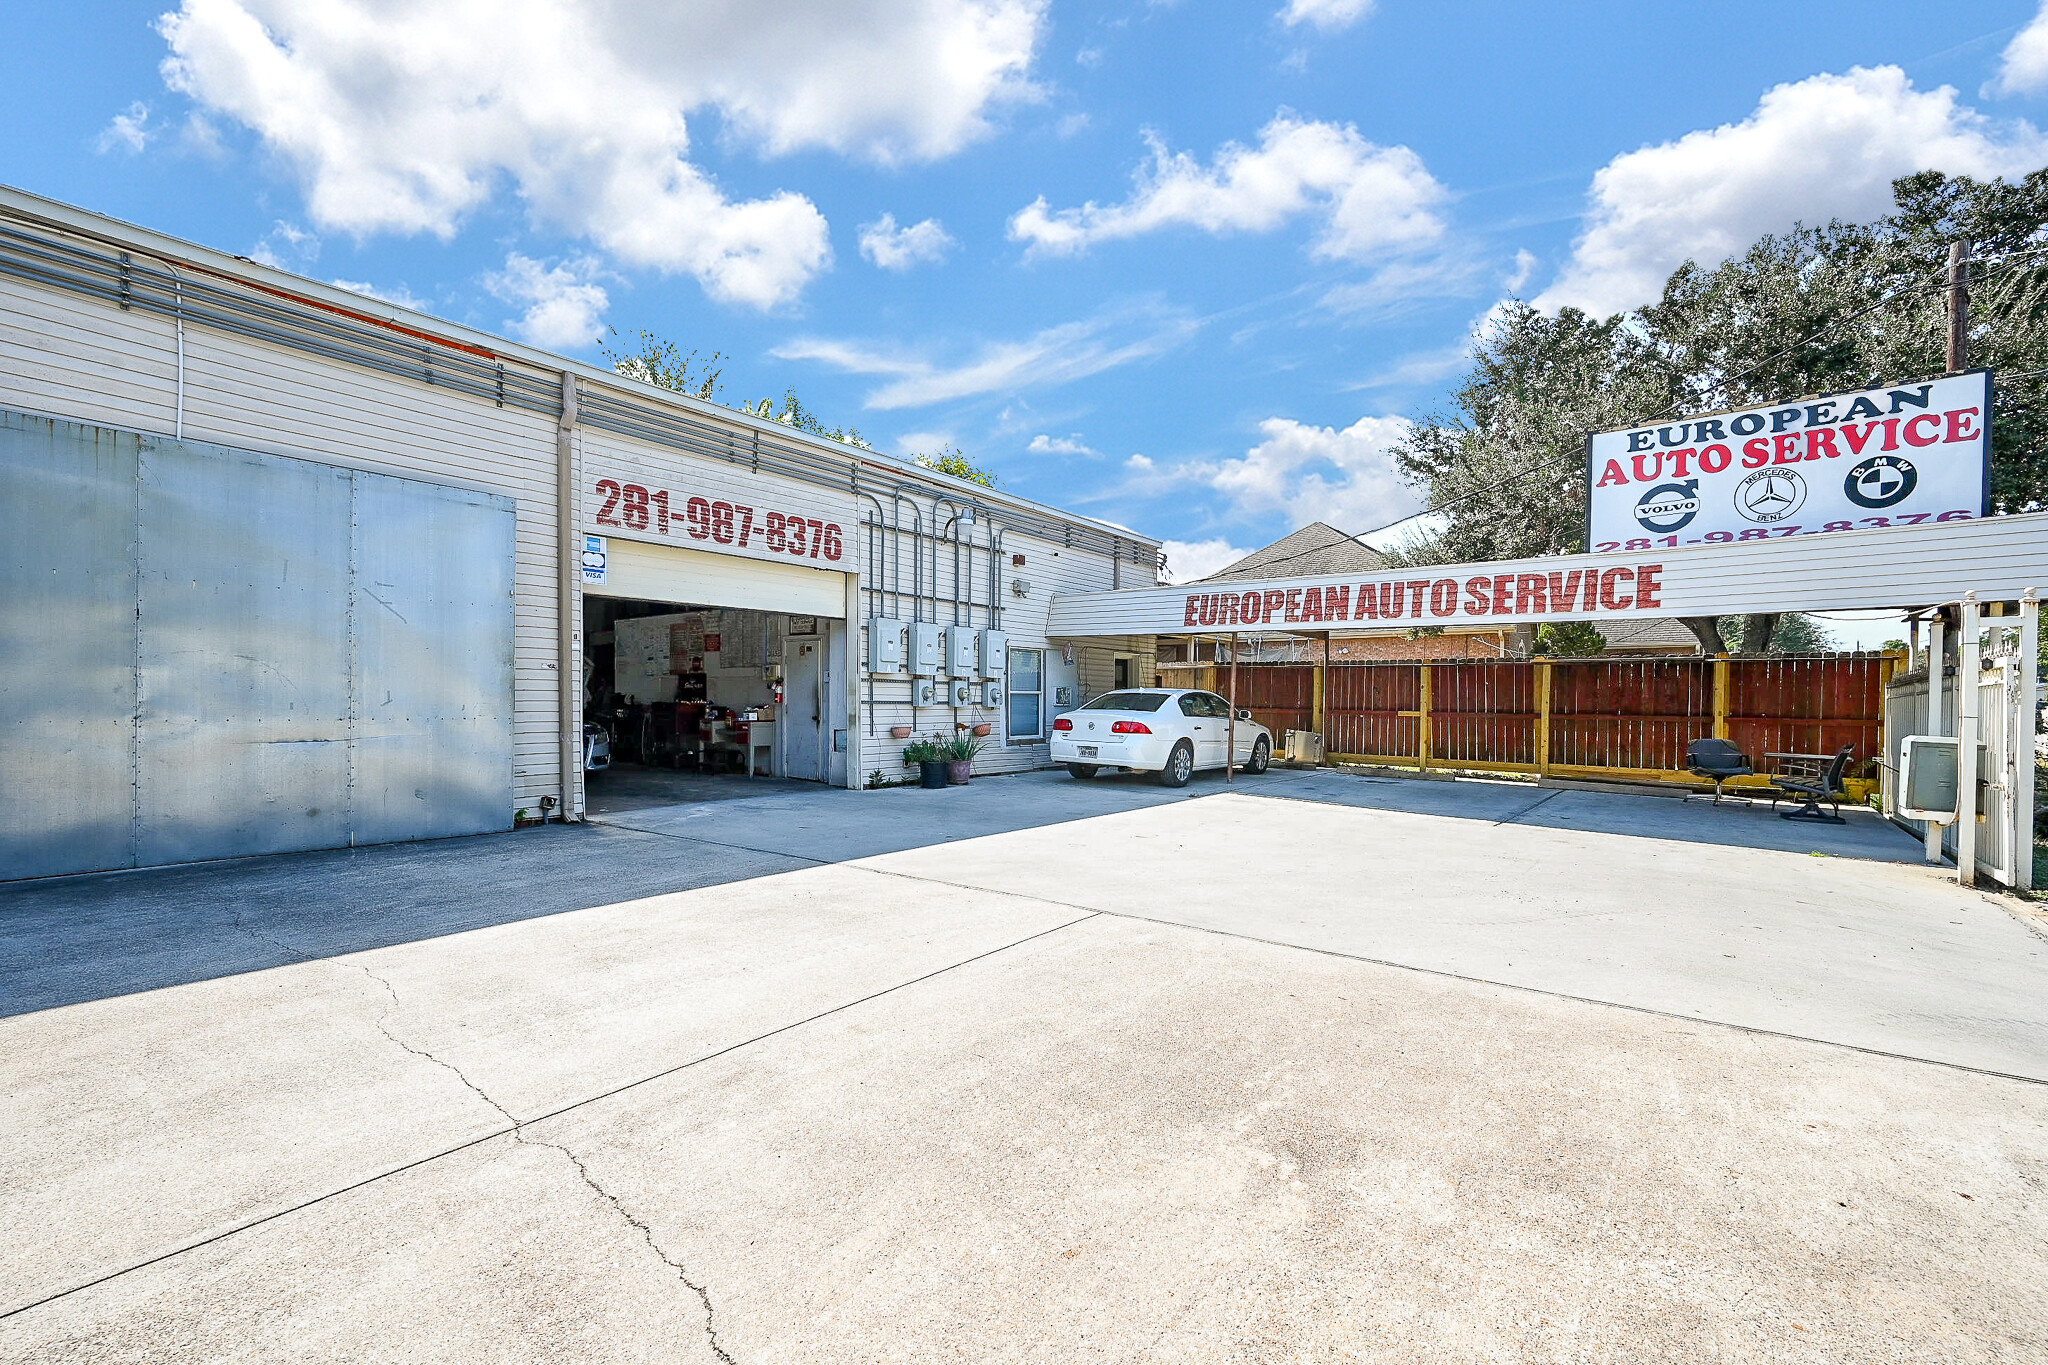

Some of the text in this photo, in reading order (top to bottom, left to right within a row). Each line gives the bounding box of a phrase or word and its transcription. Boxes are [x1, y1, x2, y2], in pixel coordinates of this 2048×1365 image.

[1627, 384, 1934, 453] EUROPEAN
[1596, 406, 1981, 488] AUTO SERVICE
[1745, 469, 1796, 485] MERCEDES
[1851, 457, 1912, 478] BMW
[1639, 502, 1696, 515] VOLVO
[1757, 513, 1783, 522] BENZ
[595, 479, 843, 562] 281-987-8376
[585, 571, 602, 579] VISA
[1184, 564, 1663, 627] EUROPEAN AUTO SERVICE
